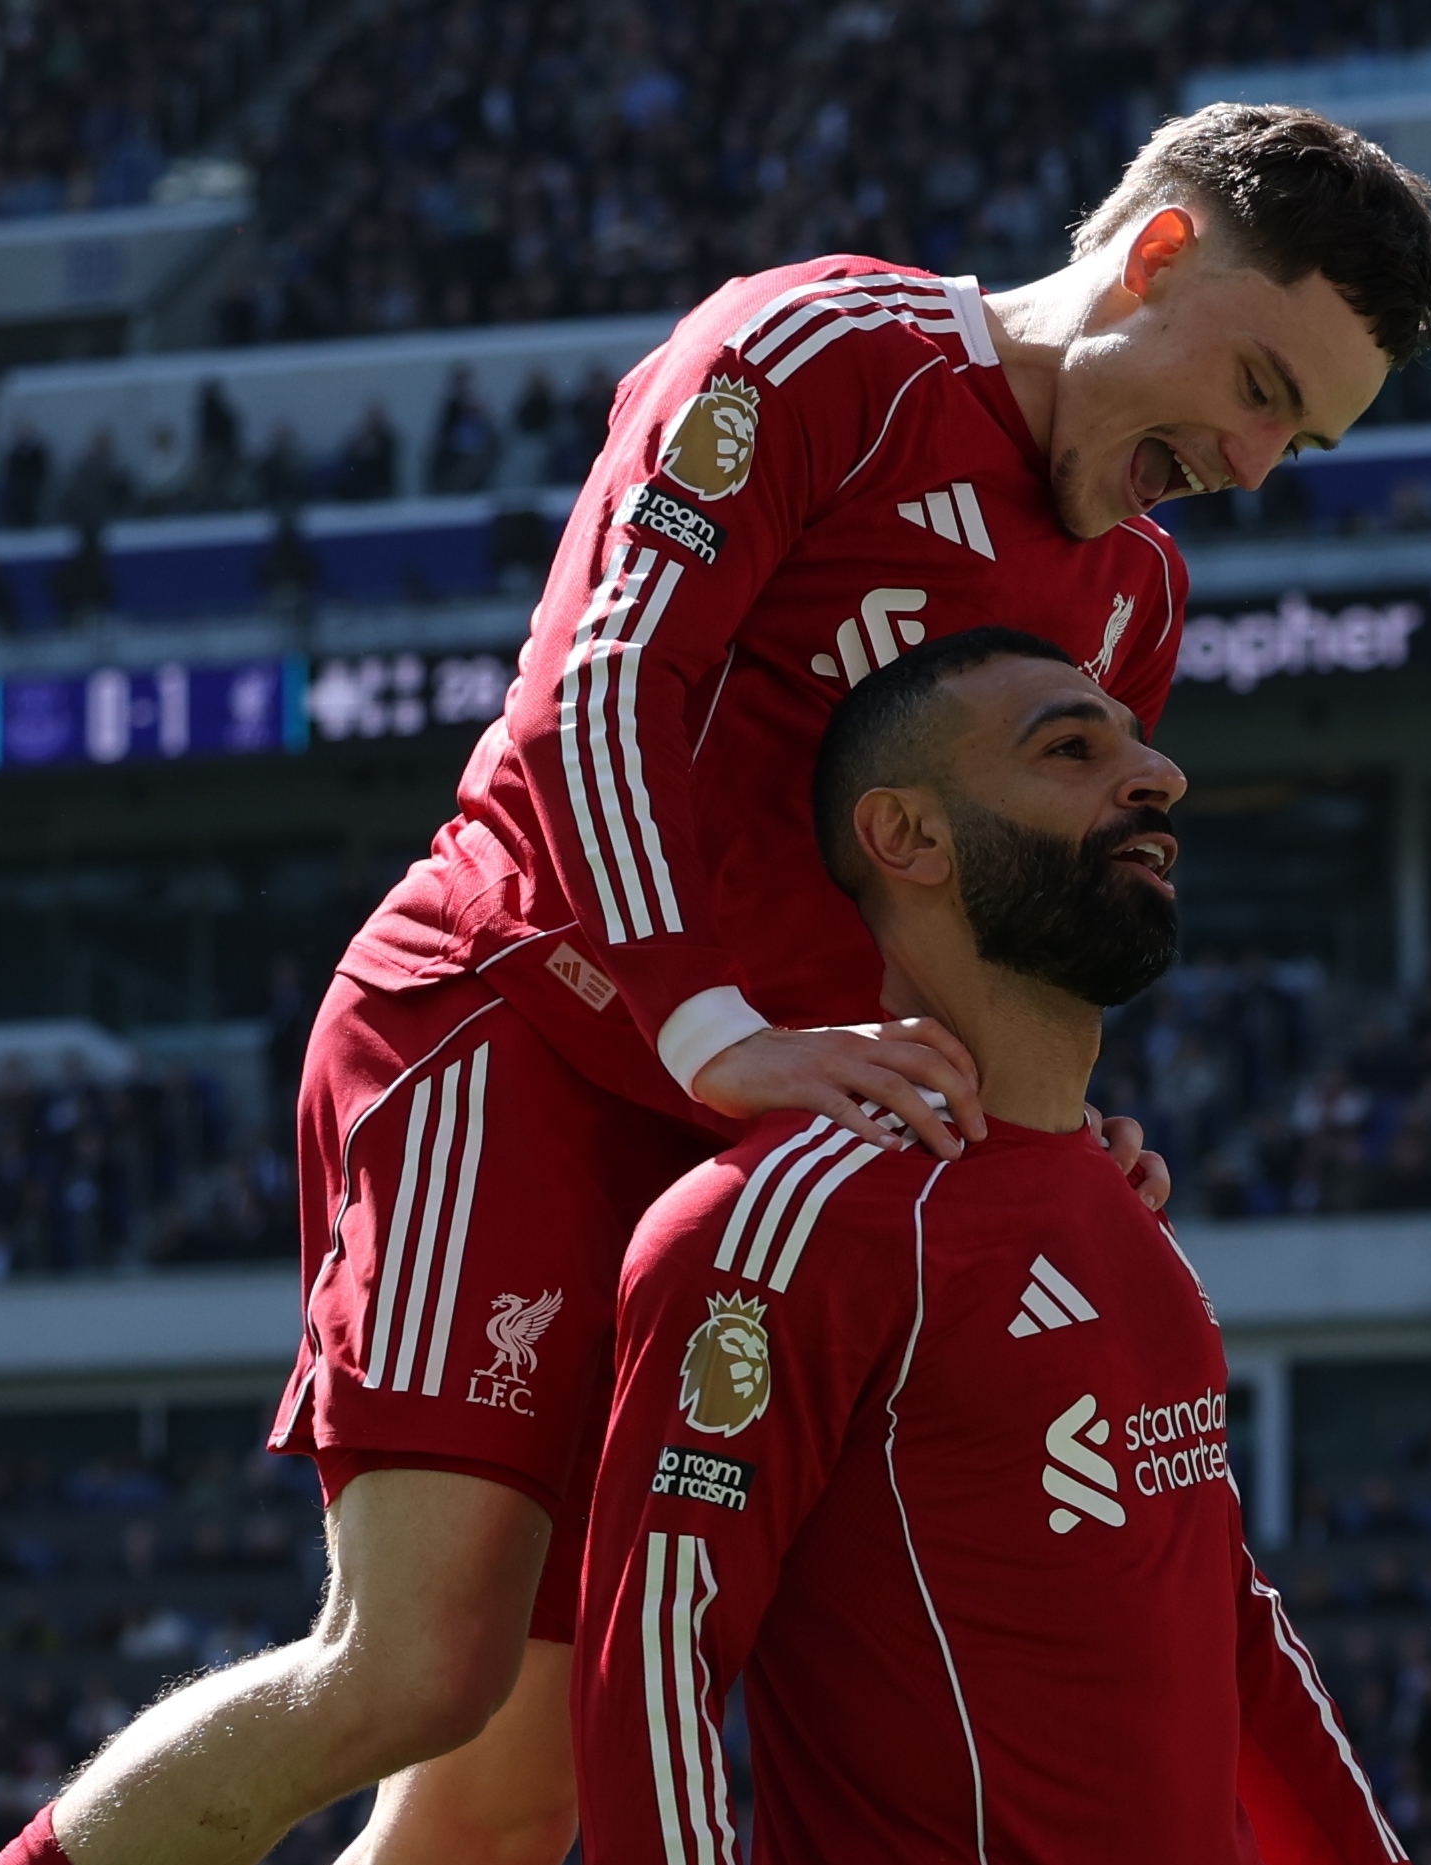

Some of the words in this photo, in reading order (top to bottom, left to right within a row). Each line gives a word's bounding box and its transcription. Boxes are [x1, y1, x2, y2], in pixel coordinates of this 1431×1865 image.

[639, 508, 716, 565] racism
[650, 494, 715, 542] room
[465, 1377, 535, 1417] L.F.C.
[683, 1454, 742, 1487] room
[1135, 1436, 1228, 1496] charter
[652, 1473, 676, 1493] or
[678, 1476, 746, 1511] racism
